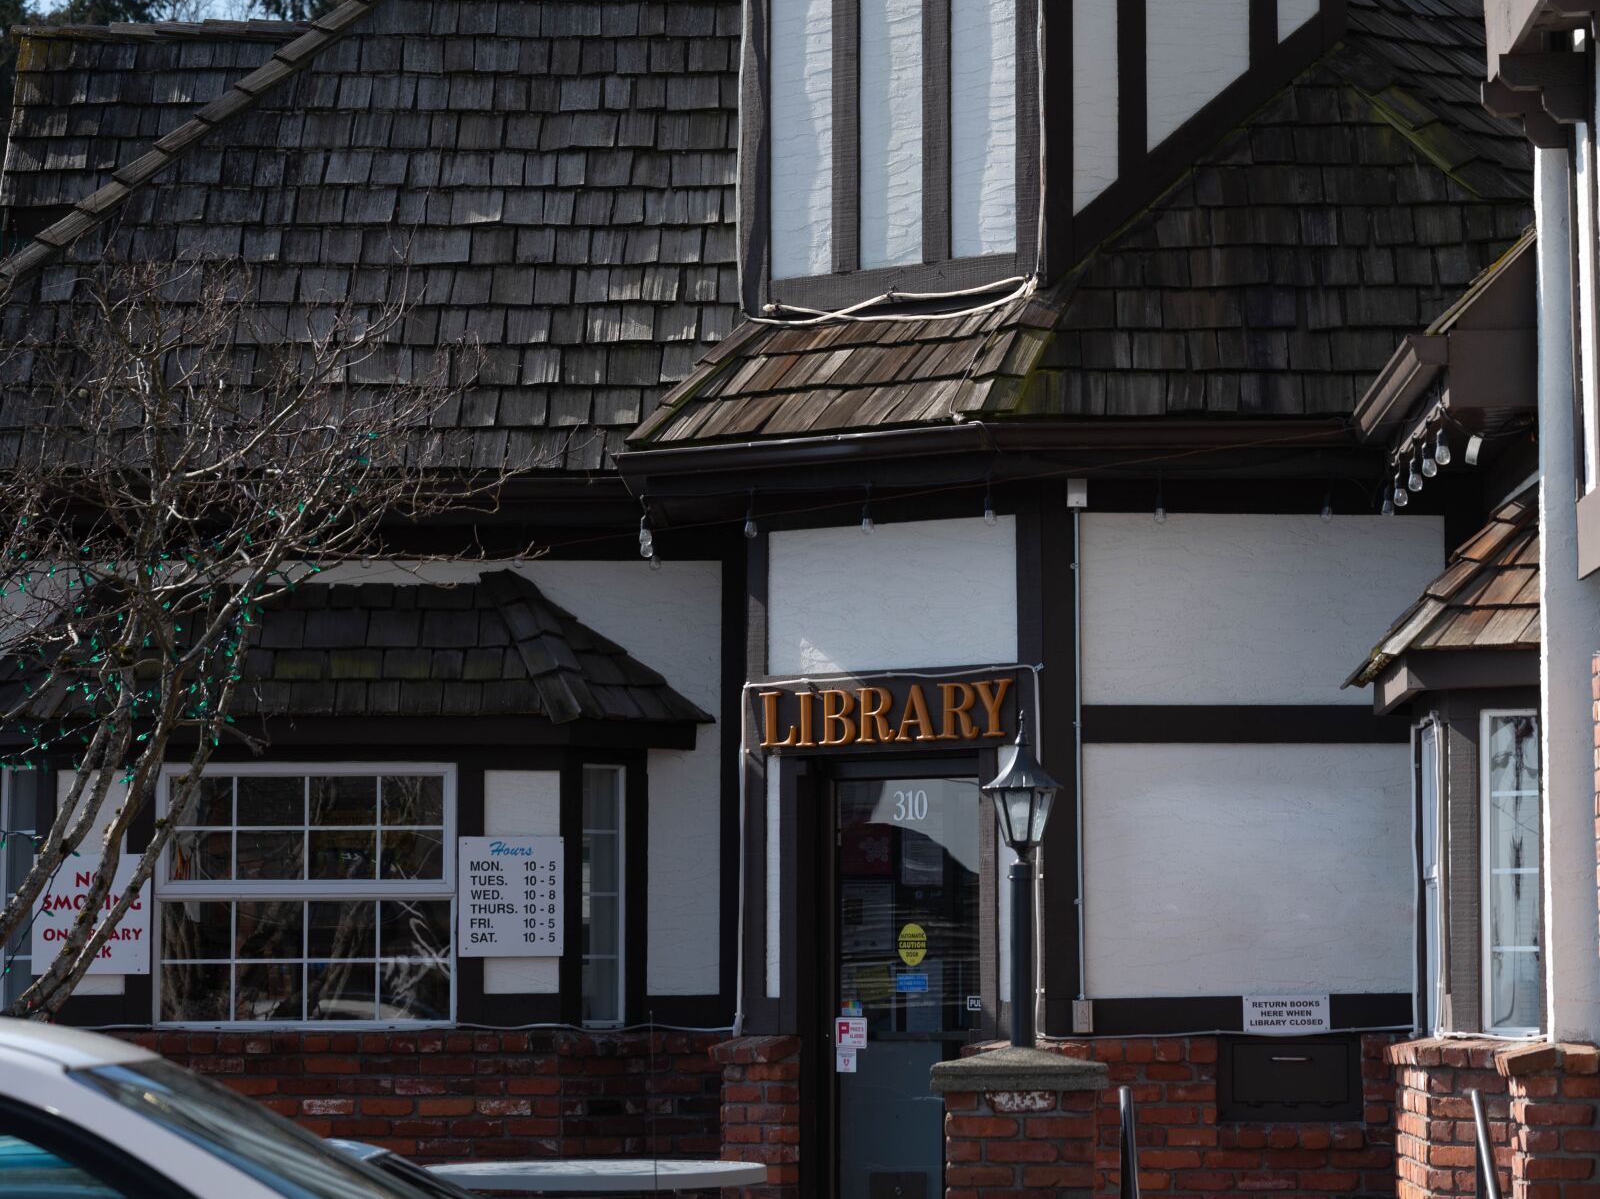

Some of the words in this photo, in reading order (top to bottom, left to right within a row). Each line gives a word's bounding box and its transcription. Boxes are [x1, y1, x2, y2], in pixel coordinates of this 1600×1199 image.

[759, 678, 1014, 748] LIBRARY
[893, 789, 928, 822] 310
[489, 841, 534, 856] Hours
[470, 861, 503, 872] MON.
[524, 861, 537, 872] 10
[548, 861, 556, 872] 5
[470, 875, 508, 886] TUES.
[524, 875, 537, 886] 10
[548, 875, 556, 886] 5
[470, 890, 504, 900] WED.
[524, 890, 536, 900] 10
[548, 890, 556, 900] 8
[42, 893, 142, 911] SMOIG
[470, 904, 518, 914] THURS.
[523, 904, 537, 914] 10
[548, 904, 555, 914] 8
[470, 918, 494, 929] FRI.
[523, 918, 537, 929] 10
[548, 918, 555, 929] 5
[43, 928, 69, 941] ON
[470, 933, 497, 943] SAT.
[522, 933, 536, 943] 10
[548, 933, 556, 943] 5
[969, 999, 981, 1007] PUL
[1290, 1000, 1320, 1008] BOOKS
[1286, 1009, 1312, 1017] WHEN
[1250, 1019, 1287, 1027] LIBRARY
[1289, 1018, 1324, 1026] CLOSED
